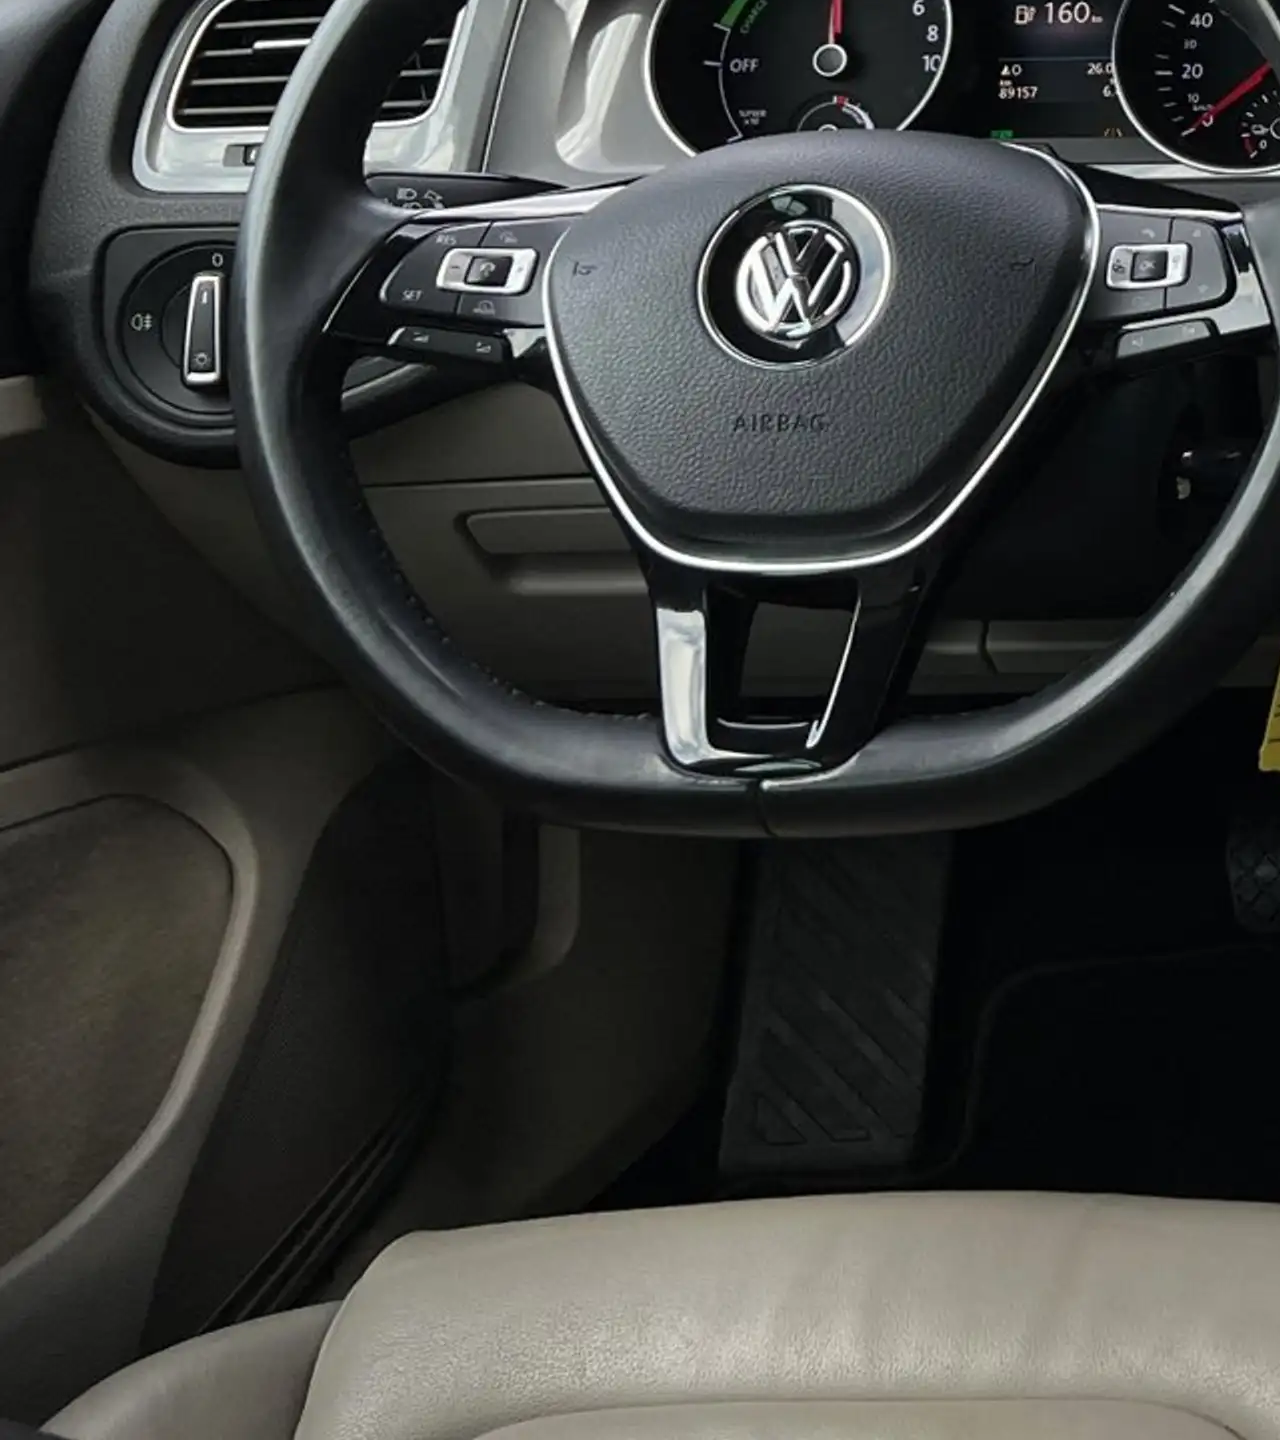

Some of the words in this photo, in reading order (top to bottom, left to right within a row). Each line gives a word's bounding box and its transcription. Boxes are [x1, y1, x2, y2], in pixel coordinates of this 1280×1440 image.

[1044, 0, 1091, 25] 160
[1189, 12, 1214, 29] 40
[926, 24, 940, 42] 8
[1183, 38, 1198, 50] 30
[729, 58, 759, 74] OFF
[921, 54, 941, 73] 10
[1181, 63, 1204, 80] 20
[998, 86, 1038, 99] 89157
[1187, 92, 1200, 104] 10
[435, 234, 457, 246] RES
[402, 289, 424, 301] SET
[732, 413, 826, 434] AIRBAG
